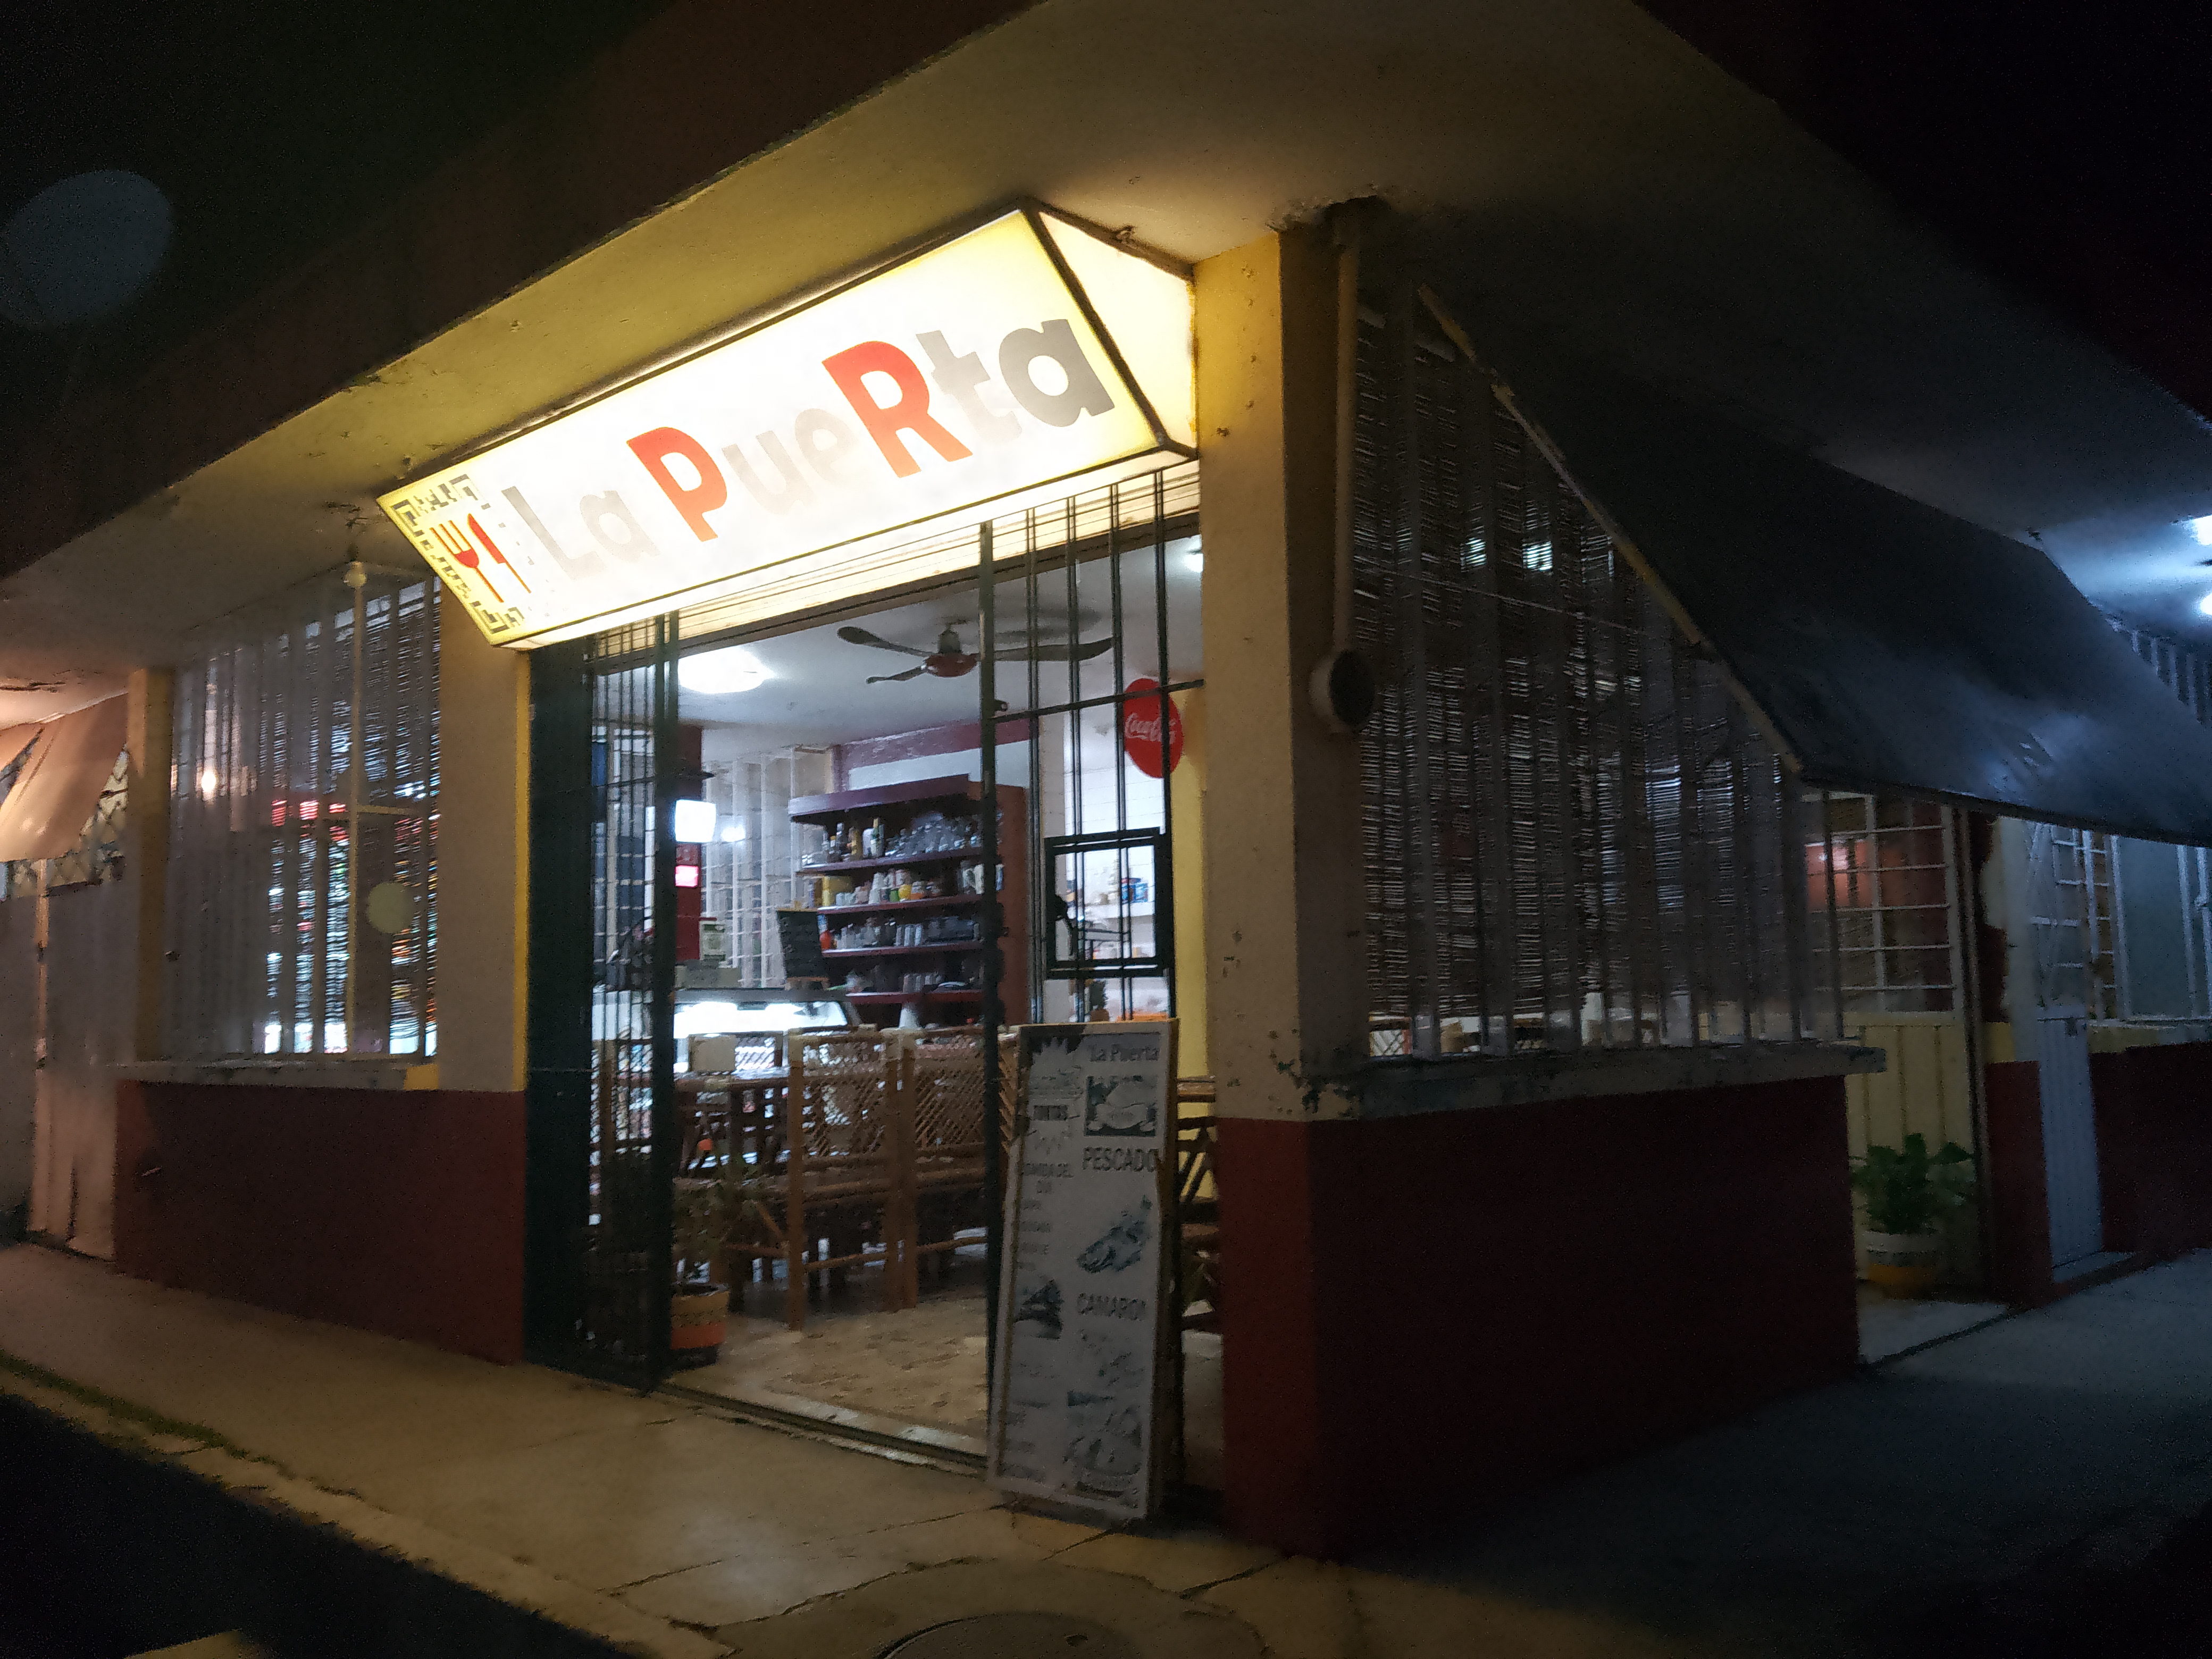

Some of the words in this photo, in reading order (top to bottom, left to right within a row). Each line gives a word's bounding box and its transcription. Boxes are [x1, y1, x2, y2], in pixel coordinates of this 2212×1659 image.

[501, 485, 660, 581] La
[626, 319, 1116, 542] PueRta
[1088, 1044, 1106, 1062] La
[1111, 1043, 1159, 1062] Puerta
